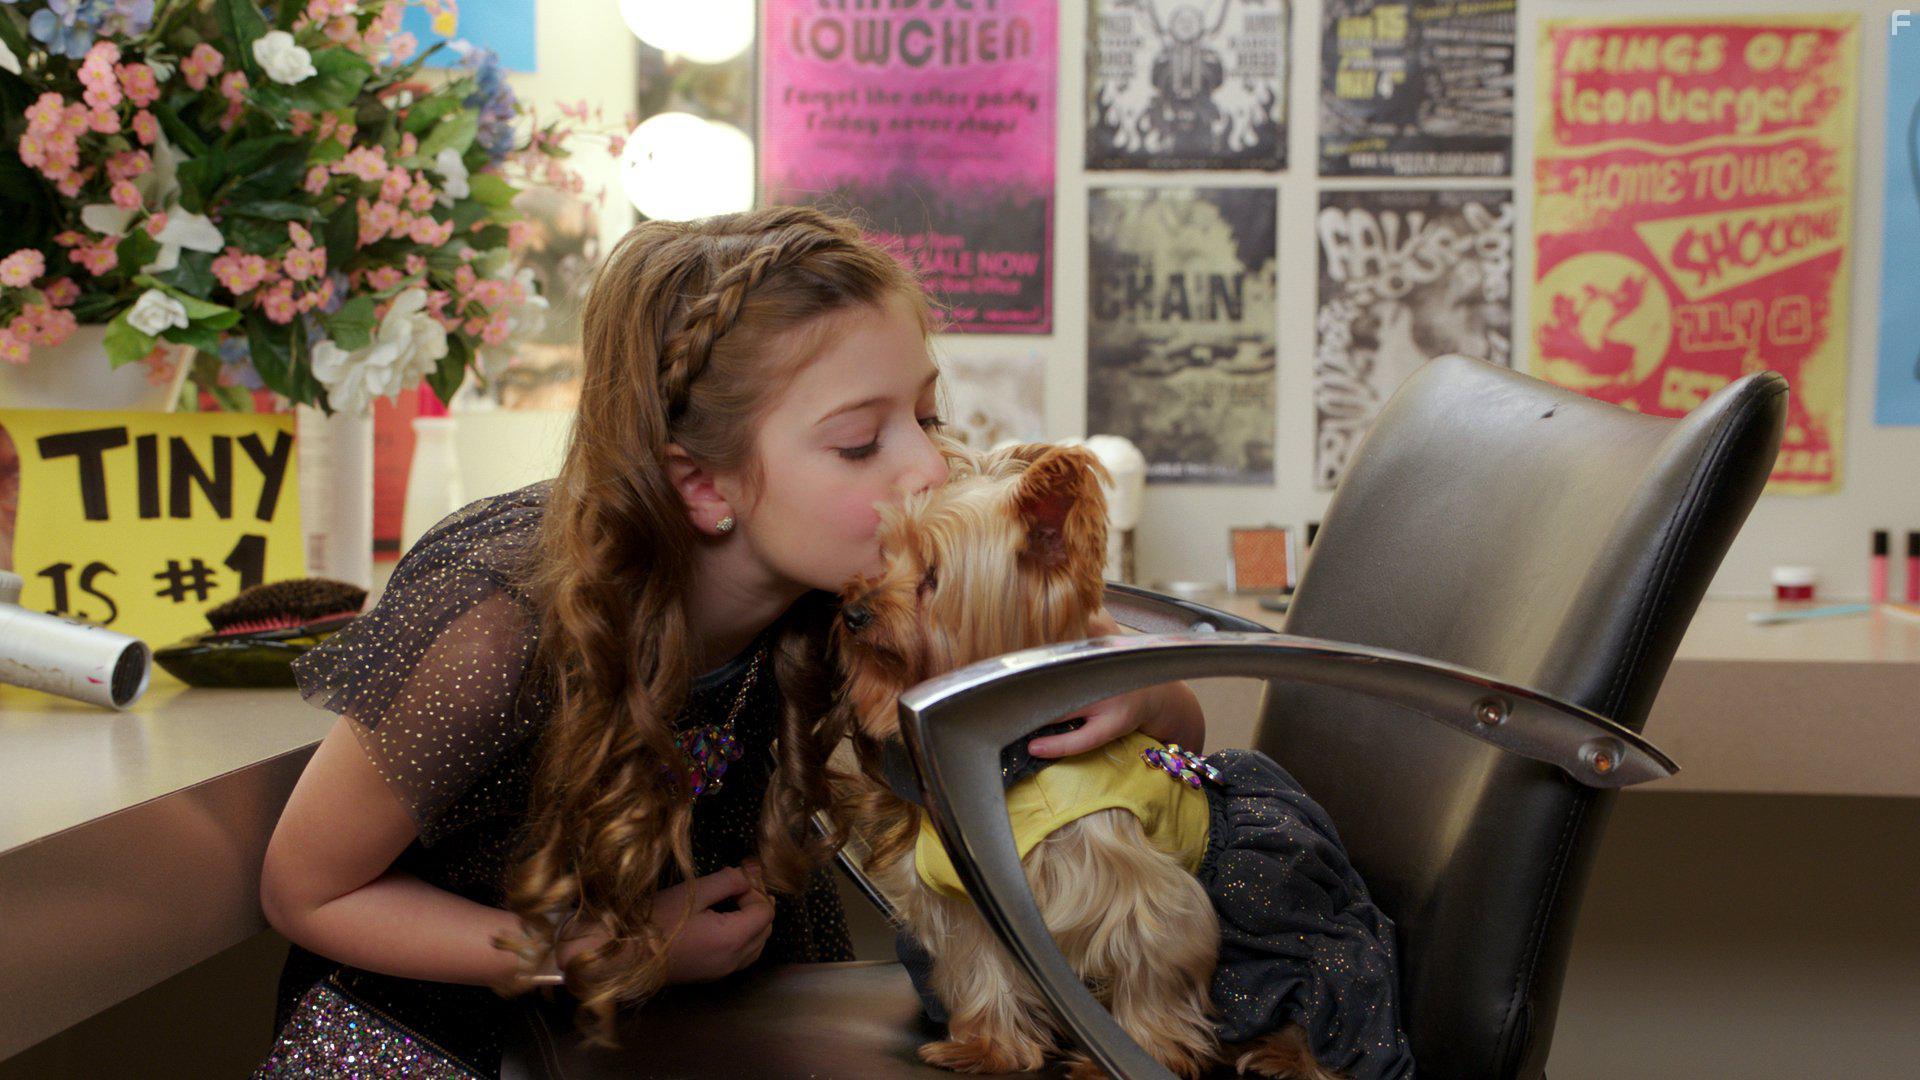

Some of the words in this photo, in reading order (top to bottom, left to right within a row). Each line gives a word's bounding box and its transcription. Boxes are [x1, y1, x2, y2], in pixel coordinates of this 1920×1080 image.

[1561, 33, 1727, 74] KINGS
[1744, 32, 1820, 71] OF
[976, 251, 1040, 277] NOW
[36, 427, 293, 522] TINY
[37, 561, 119, 625] IS
[154, 534, 267, 603] #1
